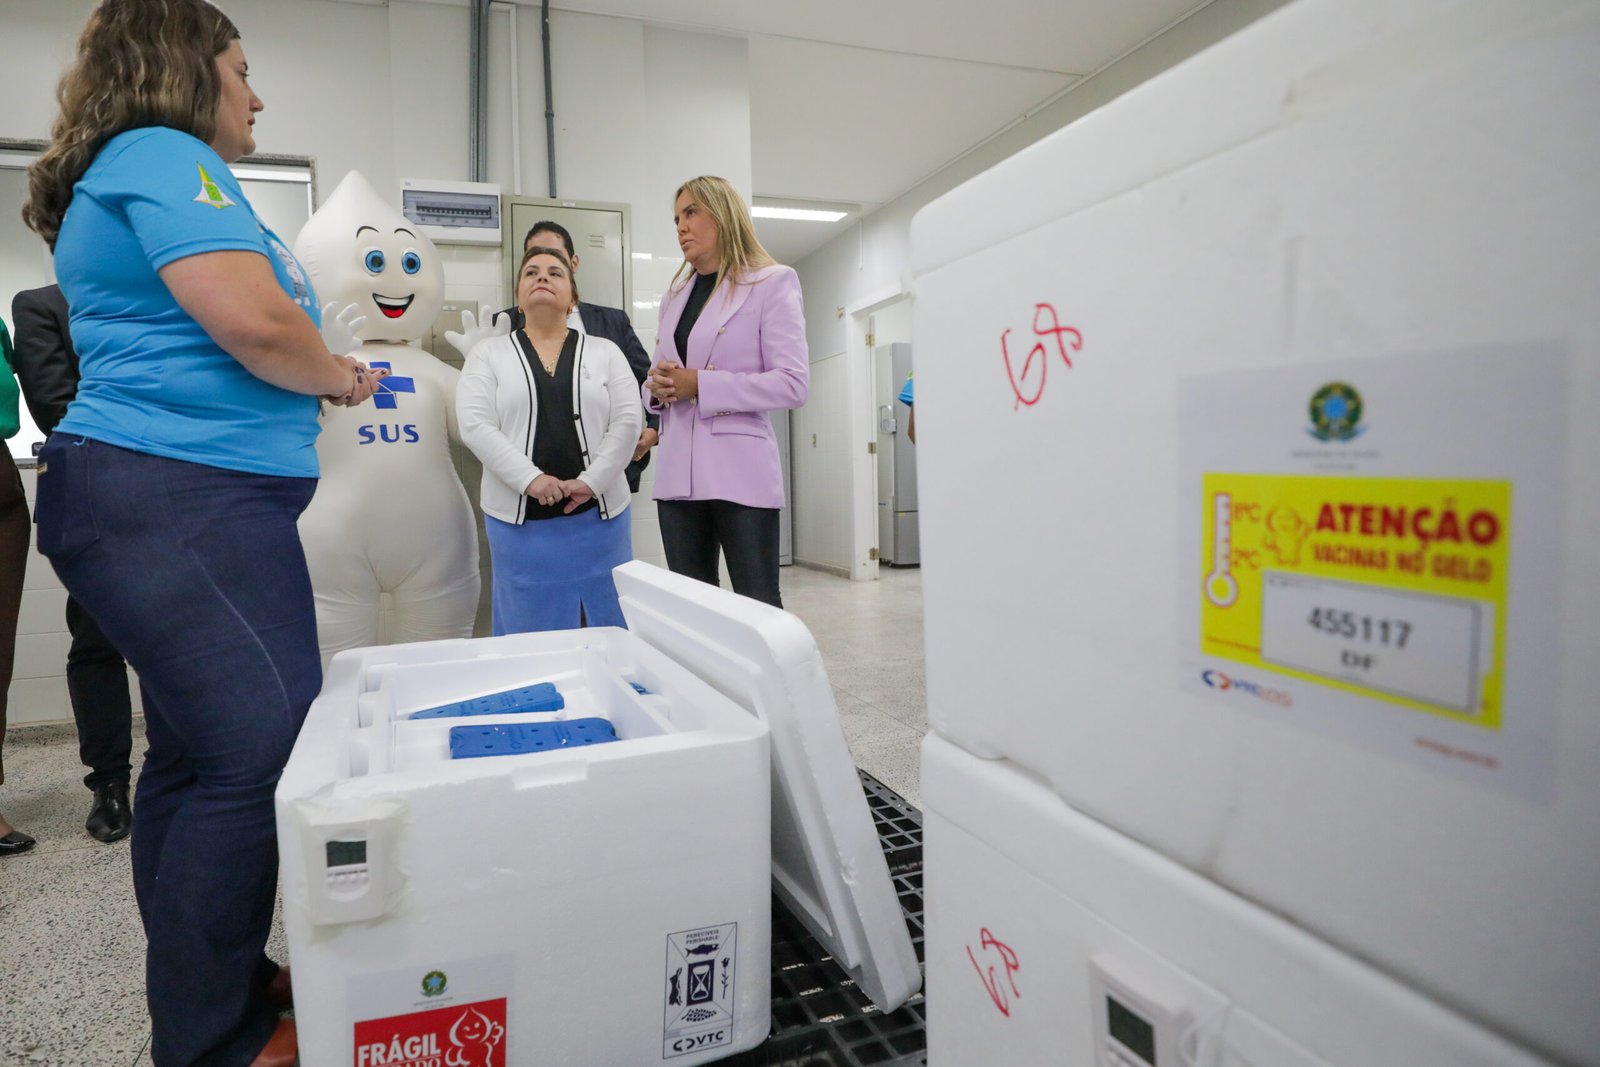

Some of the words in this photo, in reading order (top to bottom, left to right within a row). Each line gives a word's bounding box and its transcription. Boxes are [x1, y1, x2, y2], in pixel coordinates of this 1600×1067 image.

[358, 424, 419, 445] SUS
[1315, 497, 1500, 551] ATENÇÃO
[1313, 544, 1389, 571] VACINAS
[1431, 555, 1493, 584] GELO
[1308, 606, 1413, 649] 455117
[357, 1033, 441, 1067] FRÁGIL
